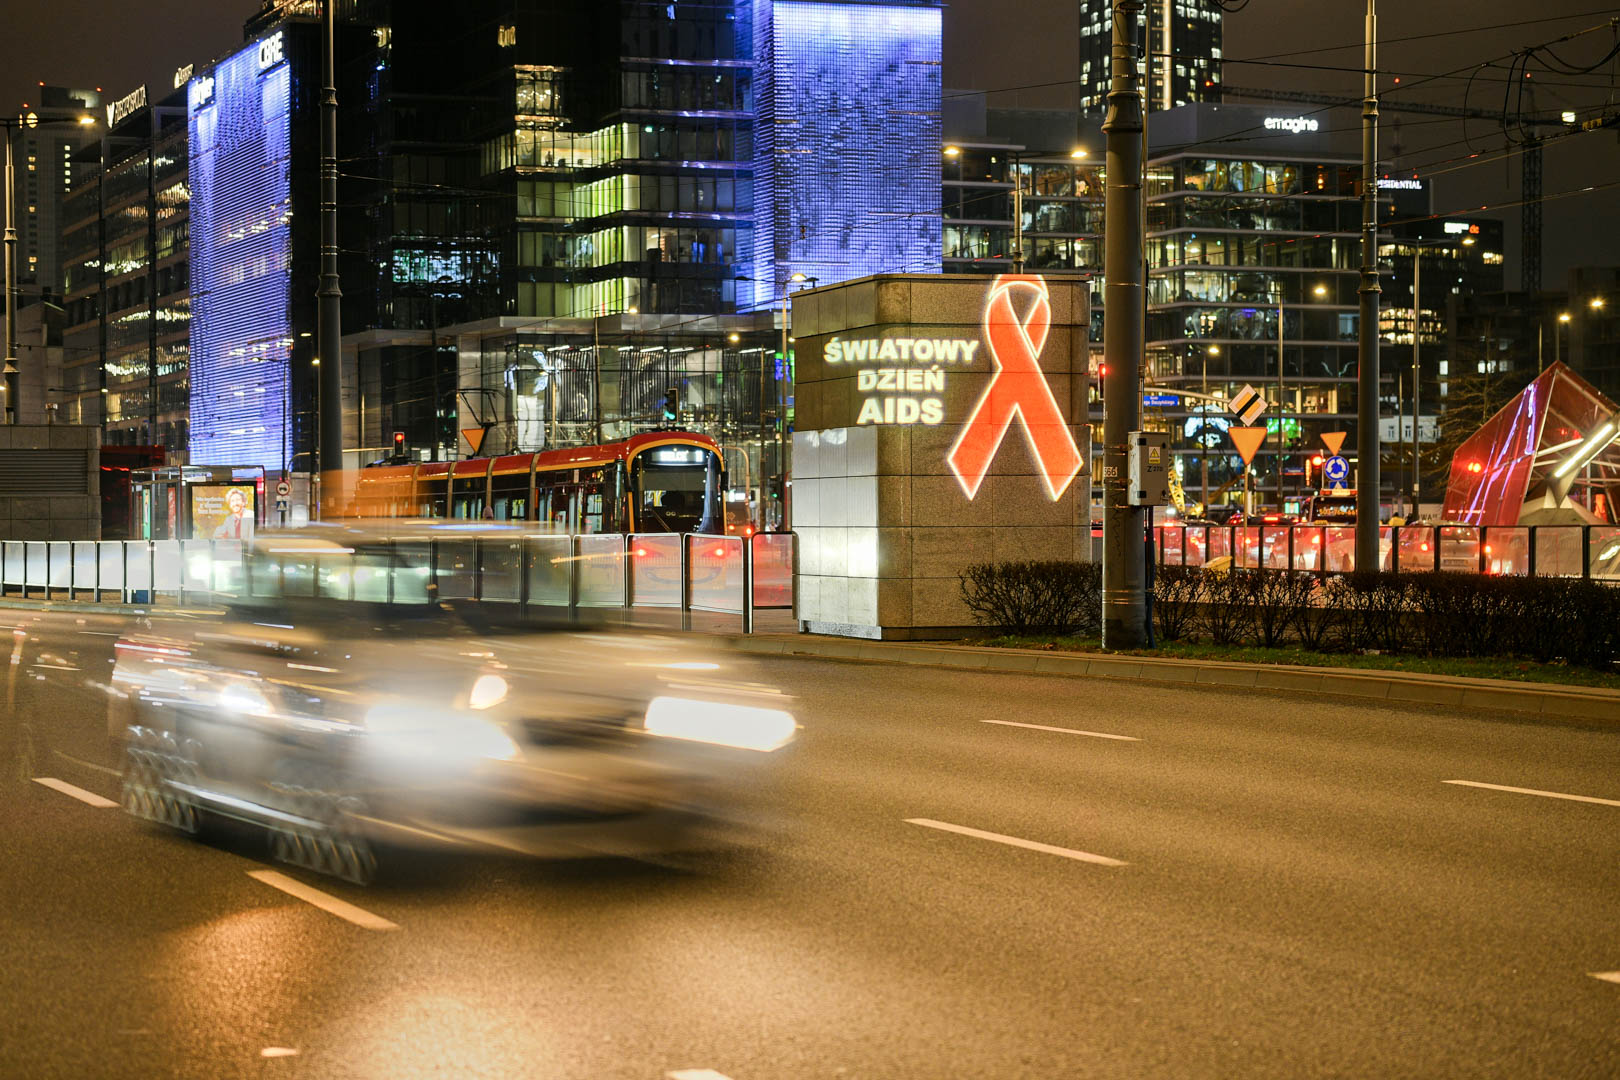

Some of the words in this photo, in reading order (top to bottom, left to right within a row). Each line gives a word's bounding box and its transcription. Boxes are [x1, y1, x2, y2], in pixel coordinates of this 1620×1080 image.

[259, 30, 283, 70] CBRE
[1263, 116, 1319, 134] emagine
[823, 336, 979, 363] ŚWIATOWY
[857, 364, 945, 391] DZIEŃ
[856, 397, 944, 425] AIDS
